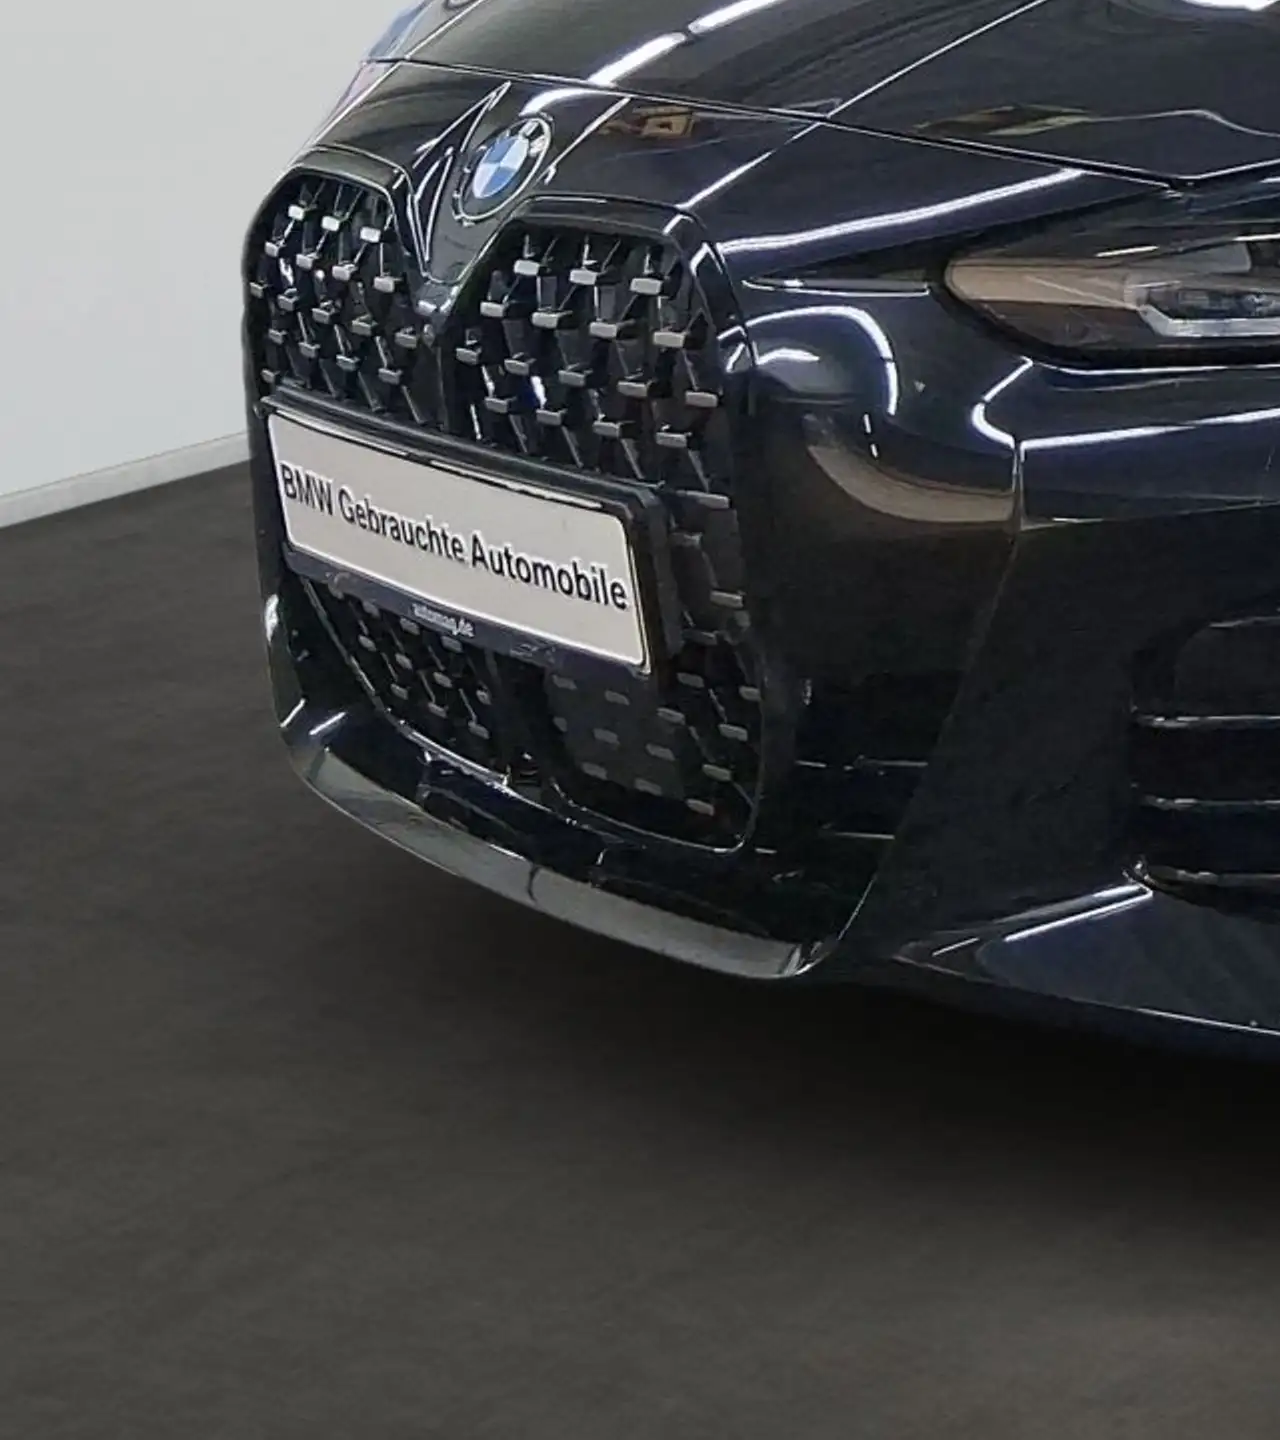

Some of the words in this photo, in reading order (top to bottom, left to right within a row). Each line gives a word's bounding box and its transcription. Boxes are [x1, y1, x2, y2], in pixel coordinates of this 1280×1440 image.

[279, 462, 334, 516] BMW
[337, 487, 466, 563] Gebrauchte
[471, 533, 628, 610] Automobile
